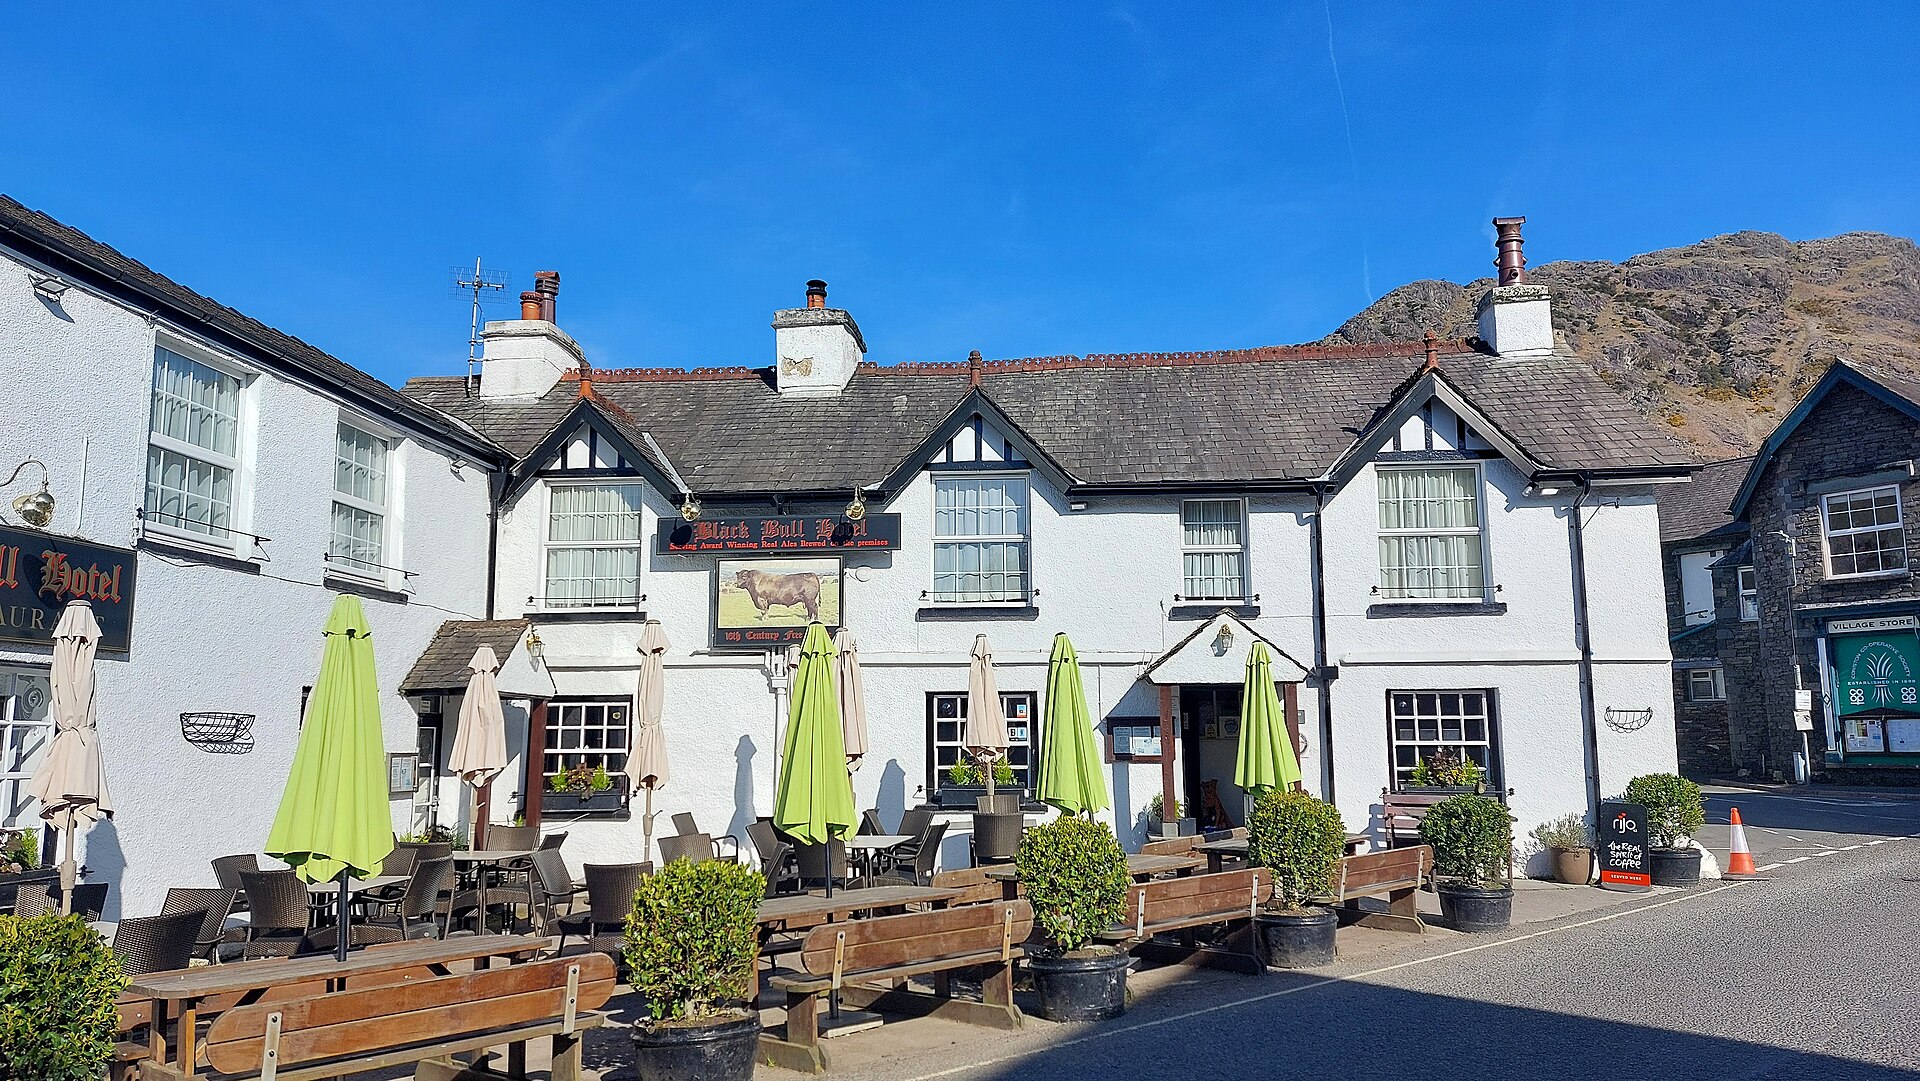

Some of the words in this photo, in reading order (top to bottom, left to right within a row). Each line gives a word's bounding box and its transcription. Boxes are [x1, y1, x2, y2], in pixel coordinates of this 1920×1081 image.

[693, 520, 750, 542] Black
[761, 519, 806, 541] Bull
[700, 541, 723, 549] Award
[726, 541, 758, 549] Winning
[761, 540, 778, 548] Real
[800, 539, 826, 547] Brewed
[857, 539, 889, 547] premises
[38, 549, 122, 604] Hotel
[1832, 621, 1875, 630] VILLAGE
[1879, 618, 1913, 627] STORE
[745, 630, 780, 641] Century
